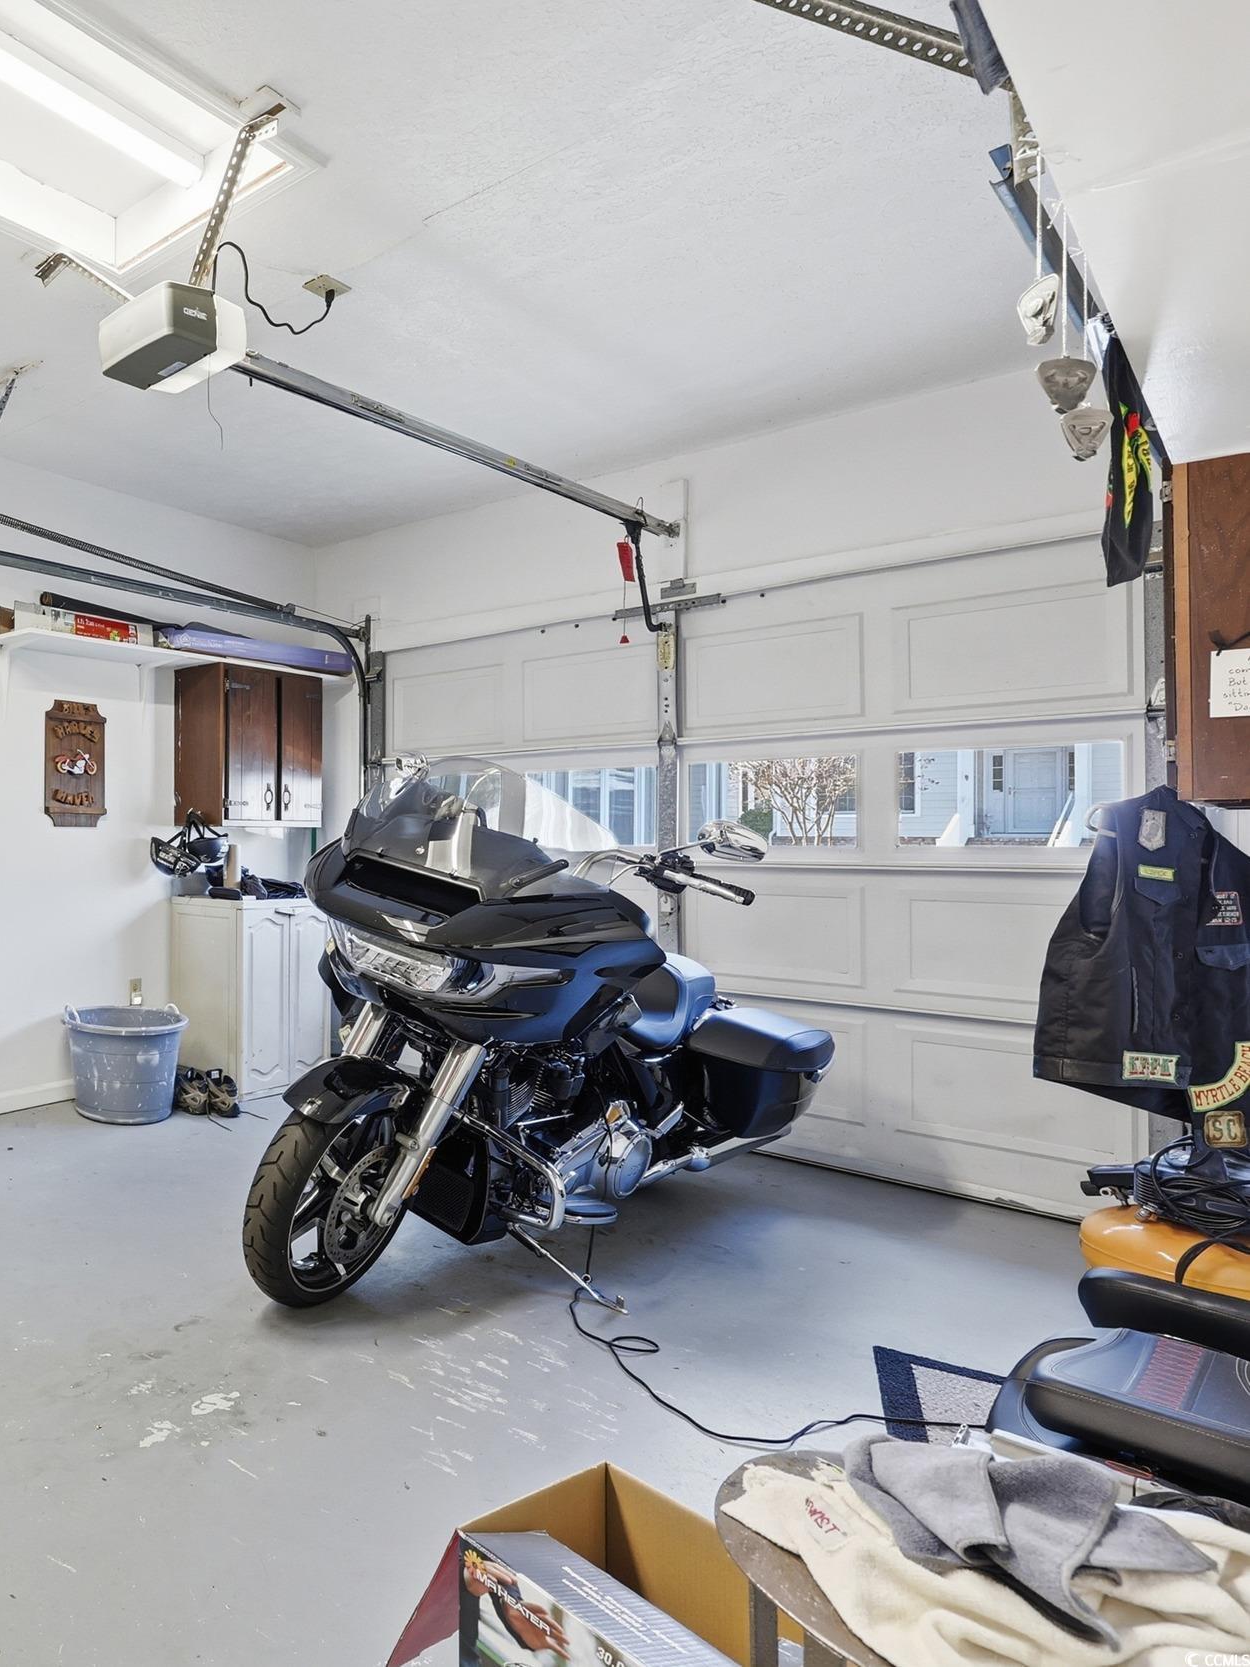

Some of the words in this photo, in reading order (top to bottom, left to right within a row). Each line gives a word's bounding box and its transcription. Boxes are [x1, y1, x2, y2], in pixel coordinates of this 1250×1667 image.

[1193, 1079, 1241, 1107] MYRTLE
[1212, 1118, 1238, 1141] SC
[498, 1584, 551, 1636] HEATER
